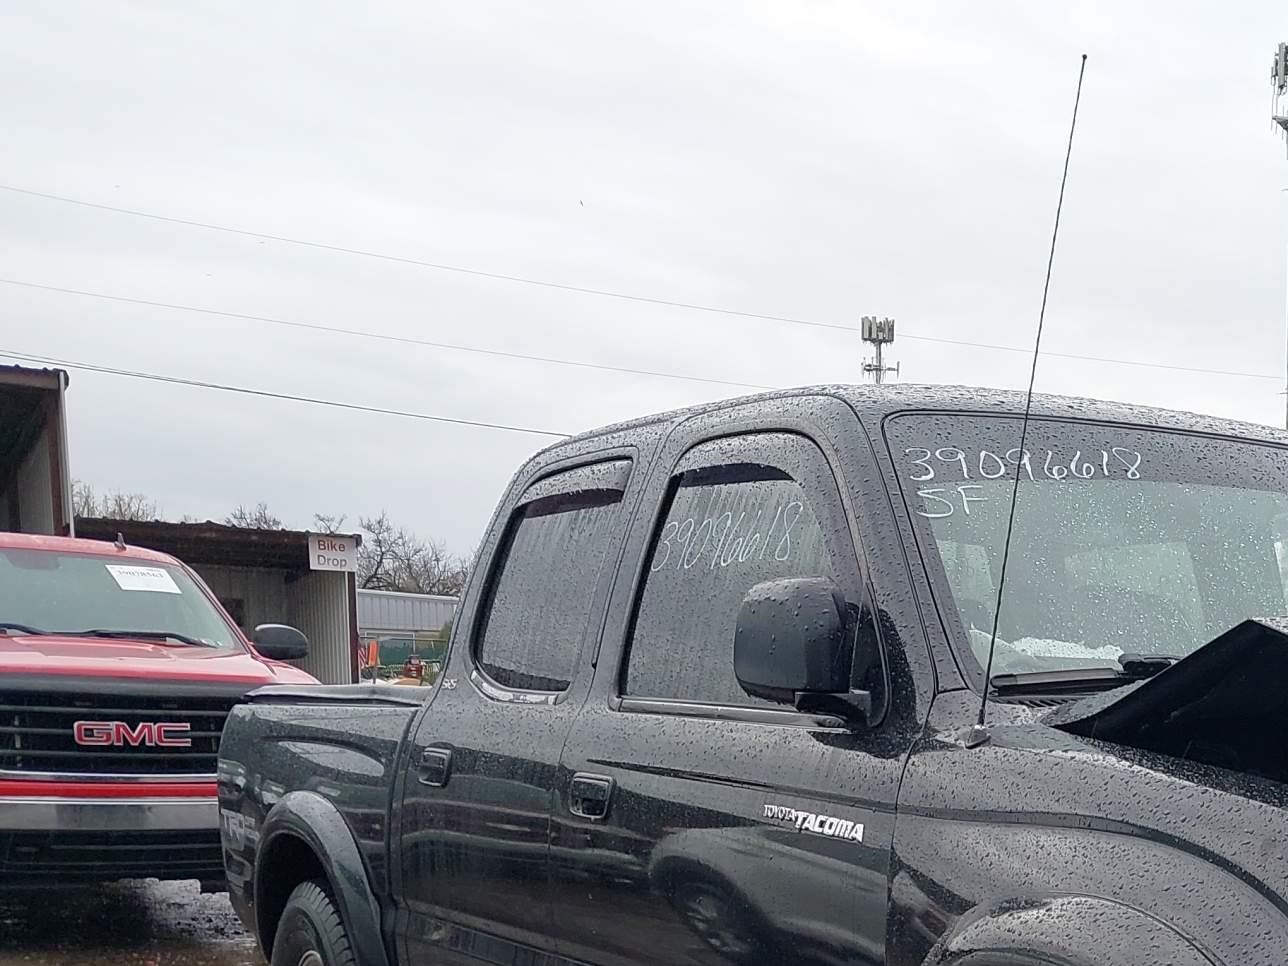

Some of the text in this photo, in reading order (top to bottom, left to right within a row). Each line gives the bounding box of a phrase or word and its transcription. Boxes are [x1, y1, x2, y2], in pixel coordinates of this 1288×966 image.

[904, 447, 1142, 481] 39096618
[916, 484, 989, 518] SF
[317, 539, 346, 552] Bike
[650, 501, 804, 572] 39096618
[317, 554, 348, 569] Drop
[73, 720, 192, 747] GMC
[762, 804, 865, 843] TOYOTA TACOMA
